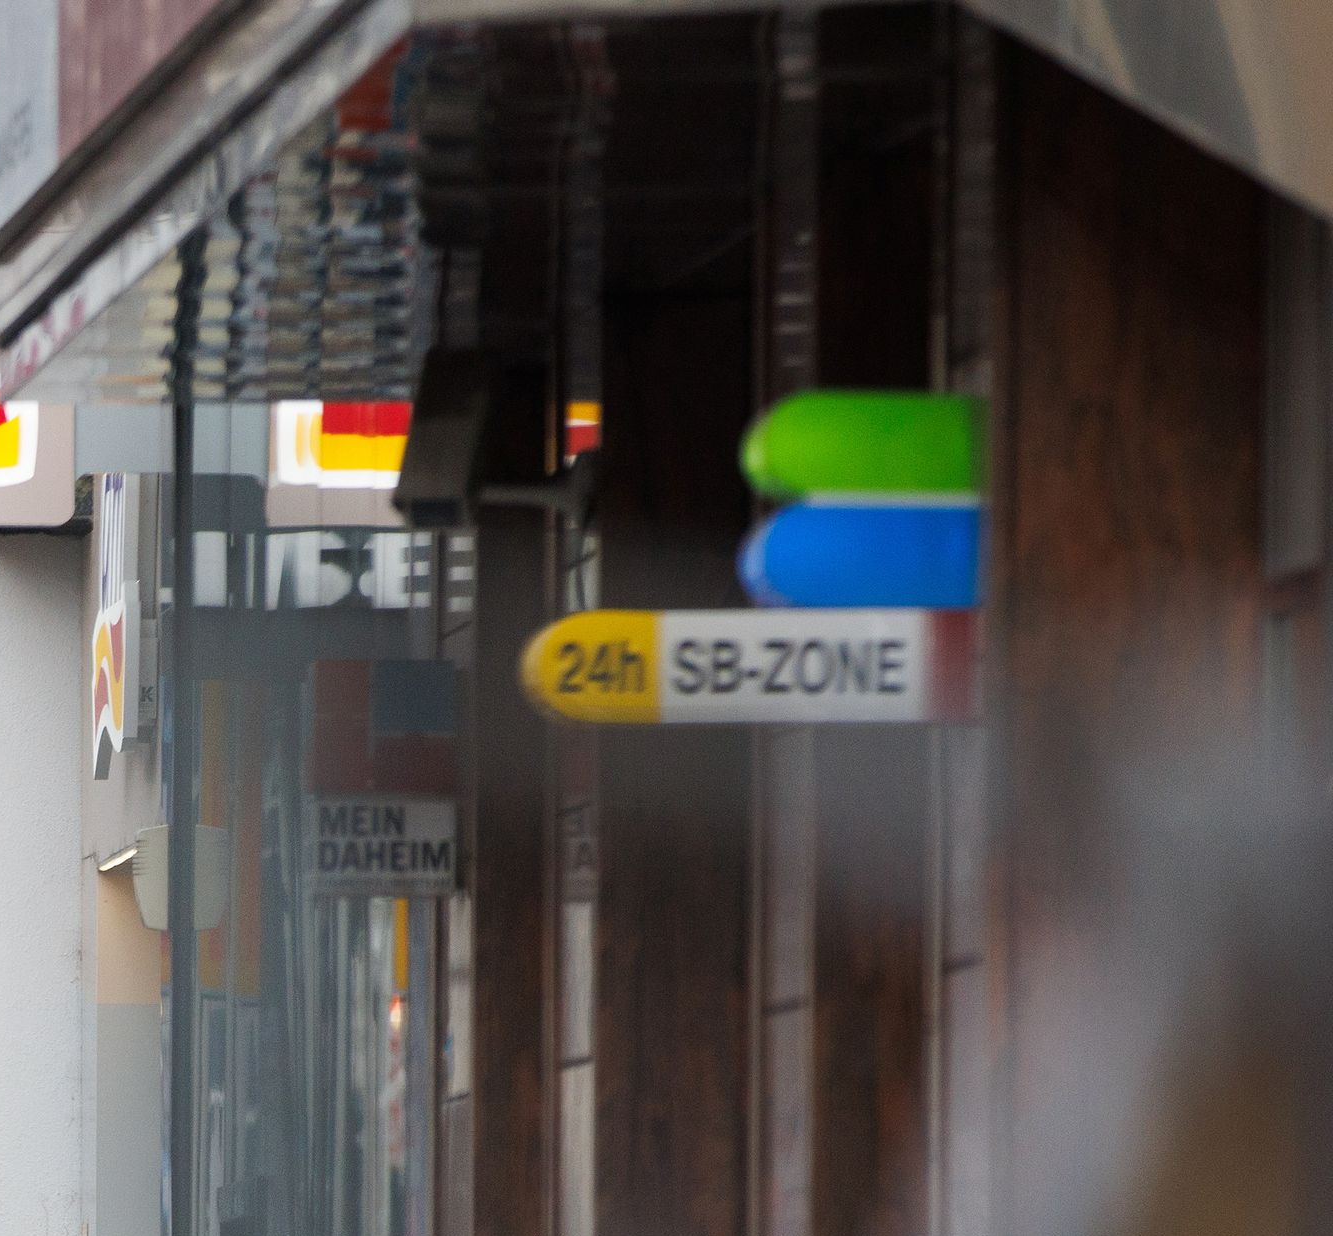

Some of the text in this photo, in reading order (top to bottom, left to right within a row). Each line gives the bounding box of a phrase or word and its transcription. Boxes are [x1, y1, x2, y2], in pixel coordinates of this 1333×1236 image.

[556, 638, 907, 696] 24h SB-ZONE
[318, 805, 407, 837] MEIN
[317, 841, 452, 873] DAHEIM
